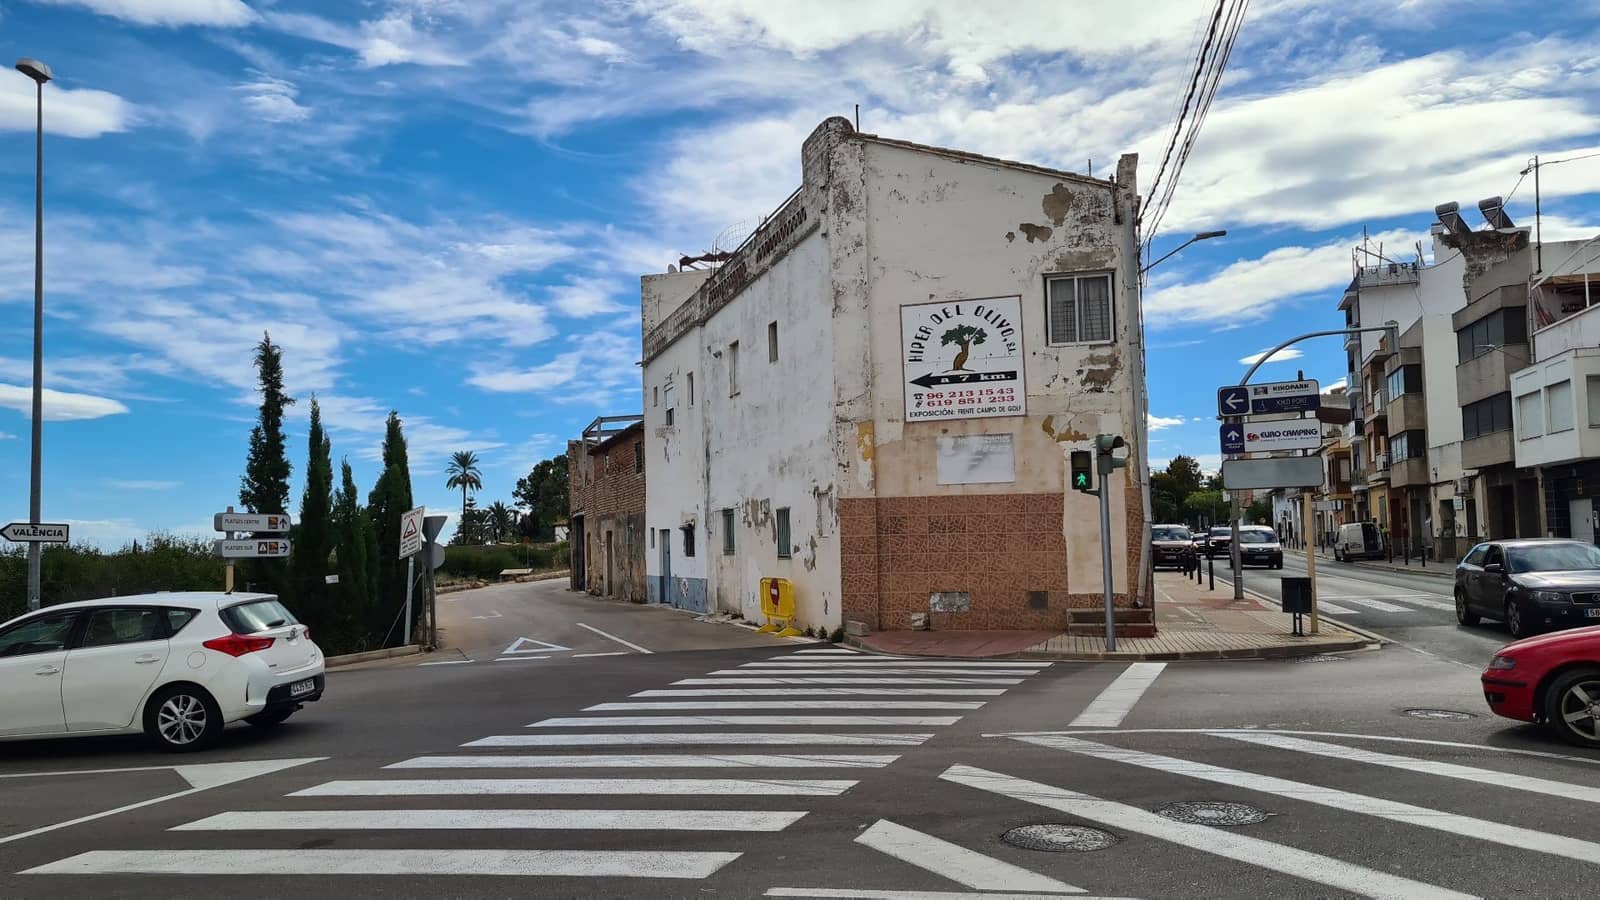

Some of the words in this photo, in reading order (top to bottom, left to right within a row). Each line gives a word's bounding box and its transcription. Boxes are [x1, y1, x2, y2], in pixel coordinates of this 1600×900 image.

[908, 325, 934, 363] HIPER
[930, 304, 964, 325] DEL
[980, 373, 1012, 381] km.
[1273, 383, 1309, 391] KIKOPARK
[926, 392, 944, 400] 96
[948, 390, 974, 398] 213
[927, 399, 953, 408] 619
[958, 397, 983, 405] 851
[989, 395, 1015, 403] 233
[957, 407, 975, 415] FRENTE
[977, 406, 998, 414] CAMPO
[1282, 428, 1318, 437] CAMPING
